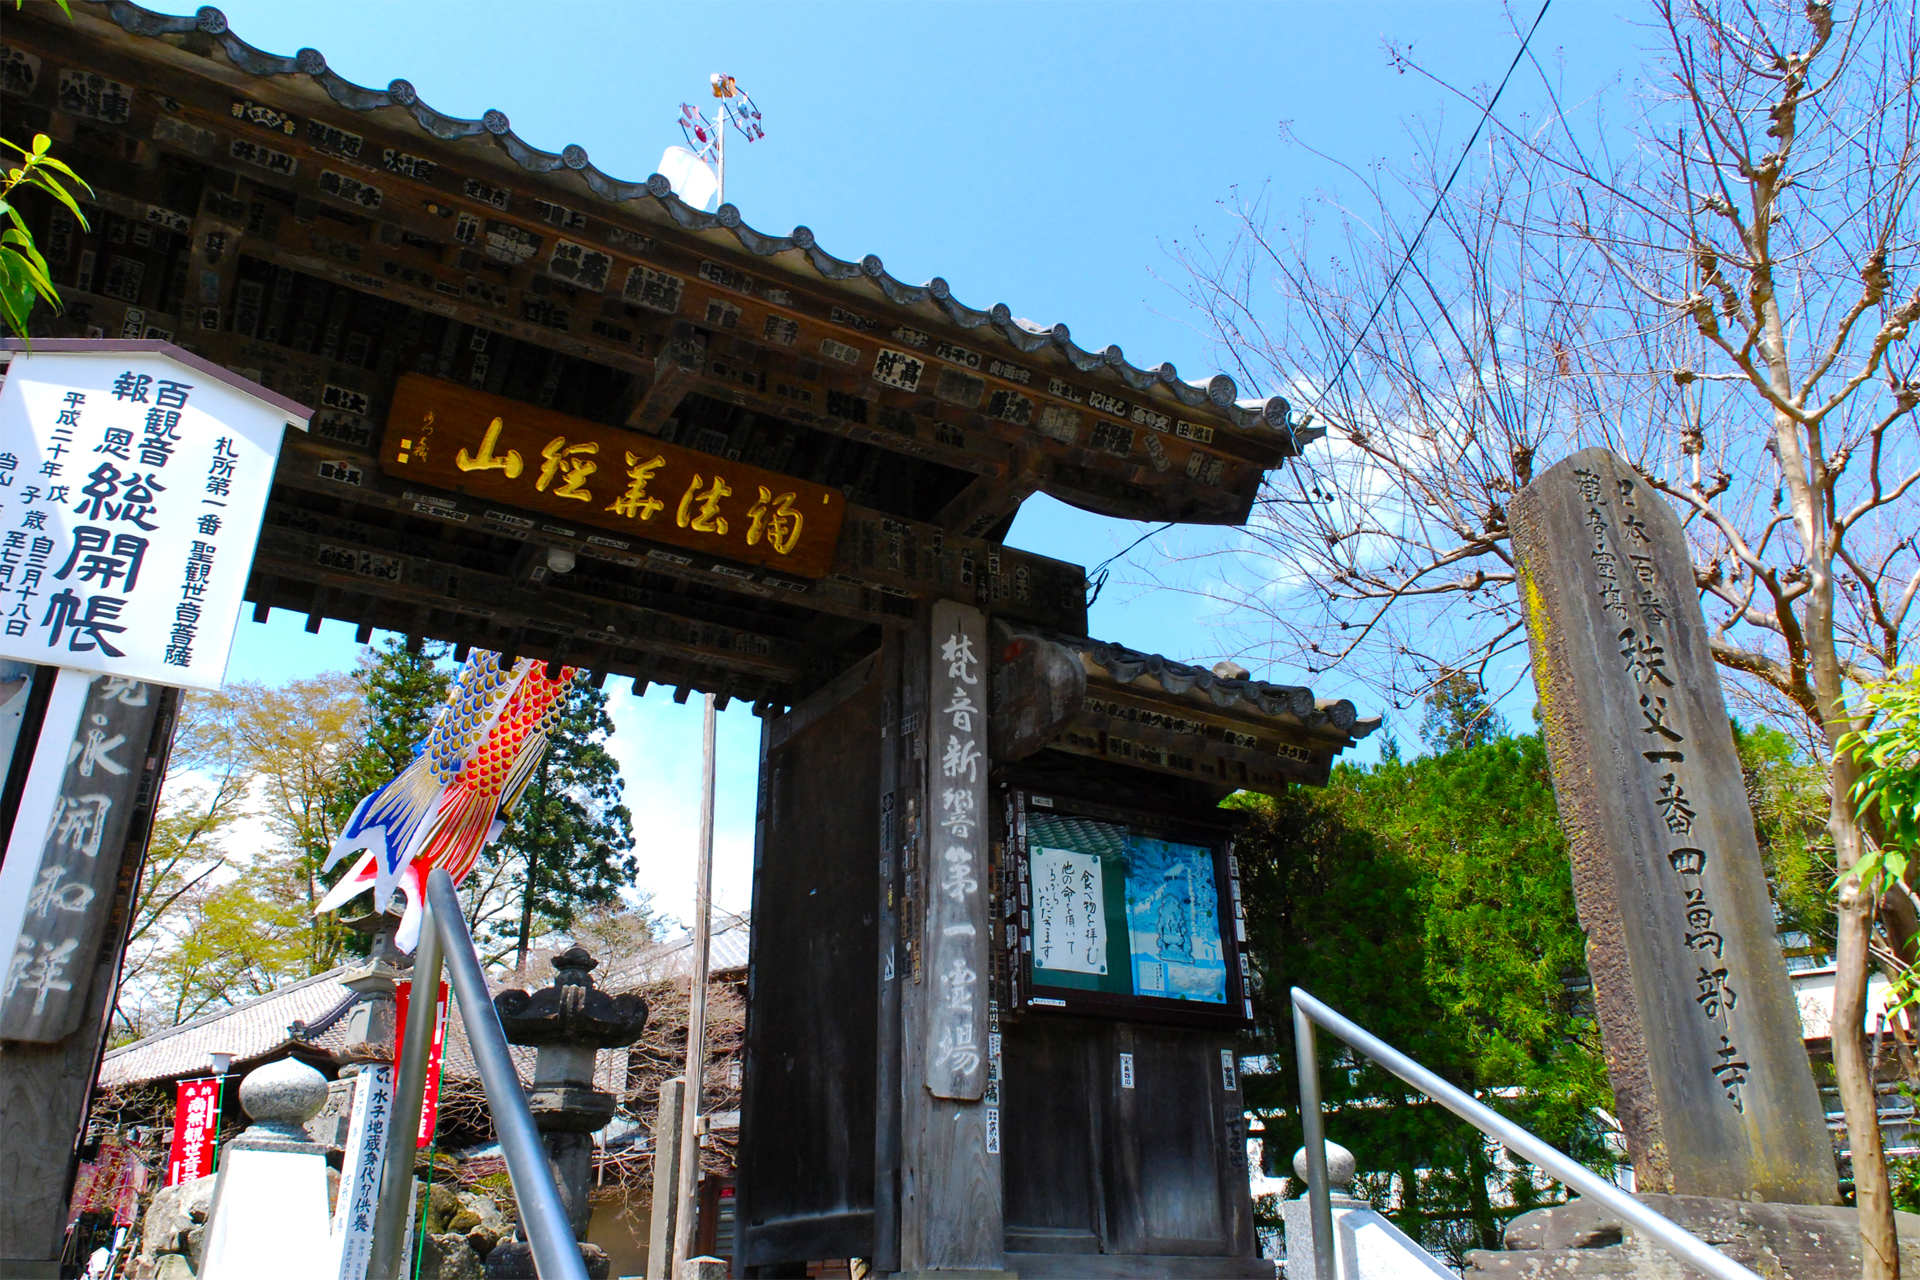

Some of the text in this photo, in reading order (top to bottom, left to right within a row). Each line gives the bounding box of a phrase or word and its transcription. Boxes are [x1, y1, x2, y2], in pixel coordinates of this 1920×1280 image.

[138, 379, 195, 468] 百観音
[40, 462, 167, 658] 総開帳
[1038, 887, 1054, 960] いただきます
[1060, 860, 1077, 955] 他の命を頂いて
[1080, 869, 1099, 965] 食べ物を拝む
